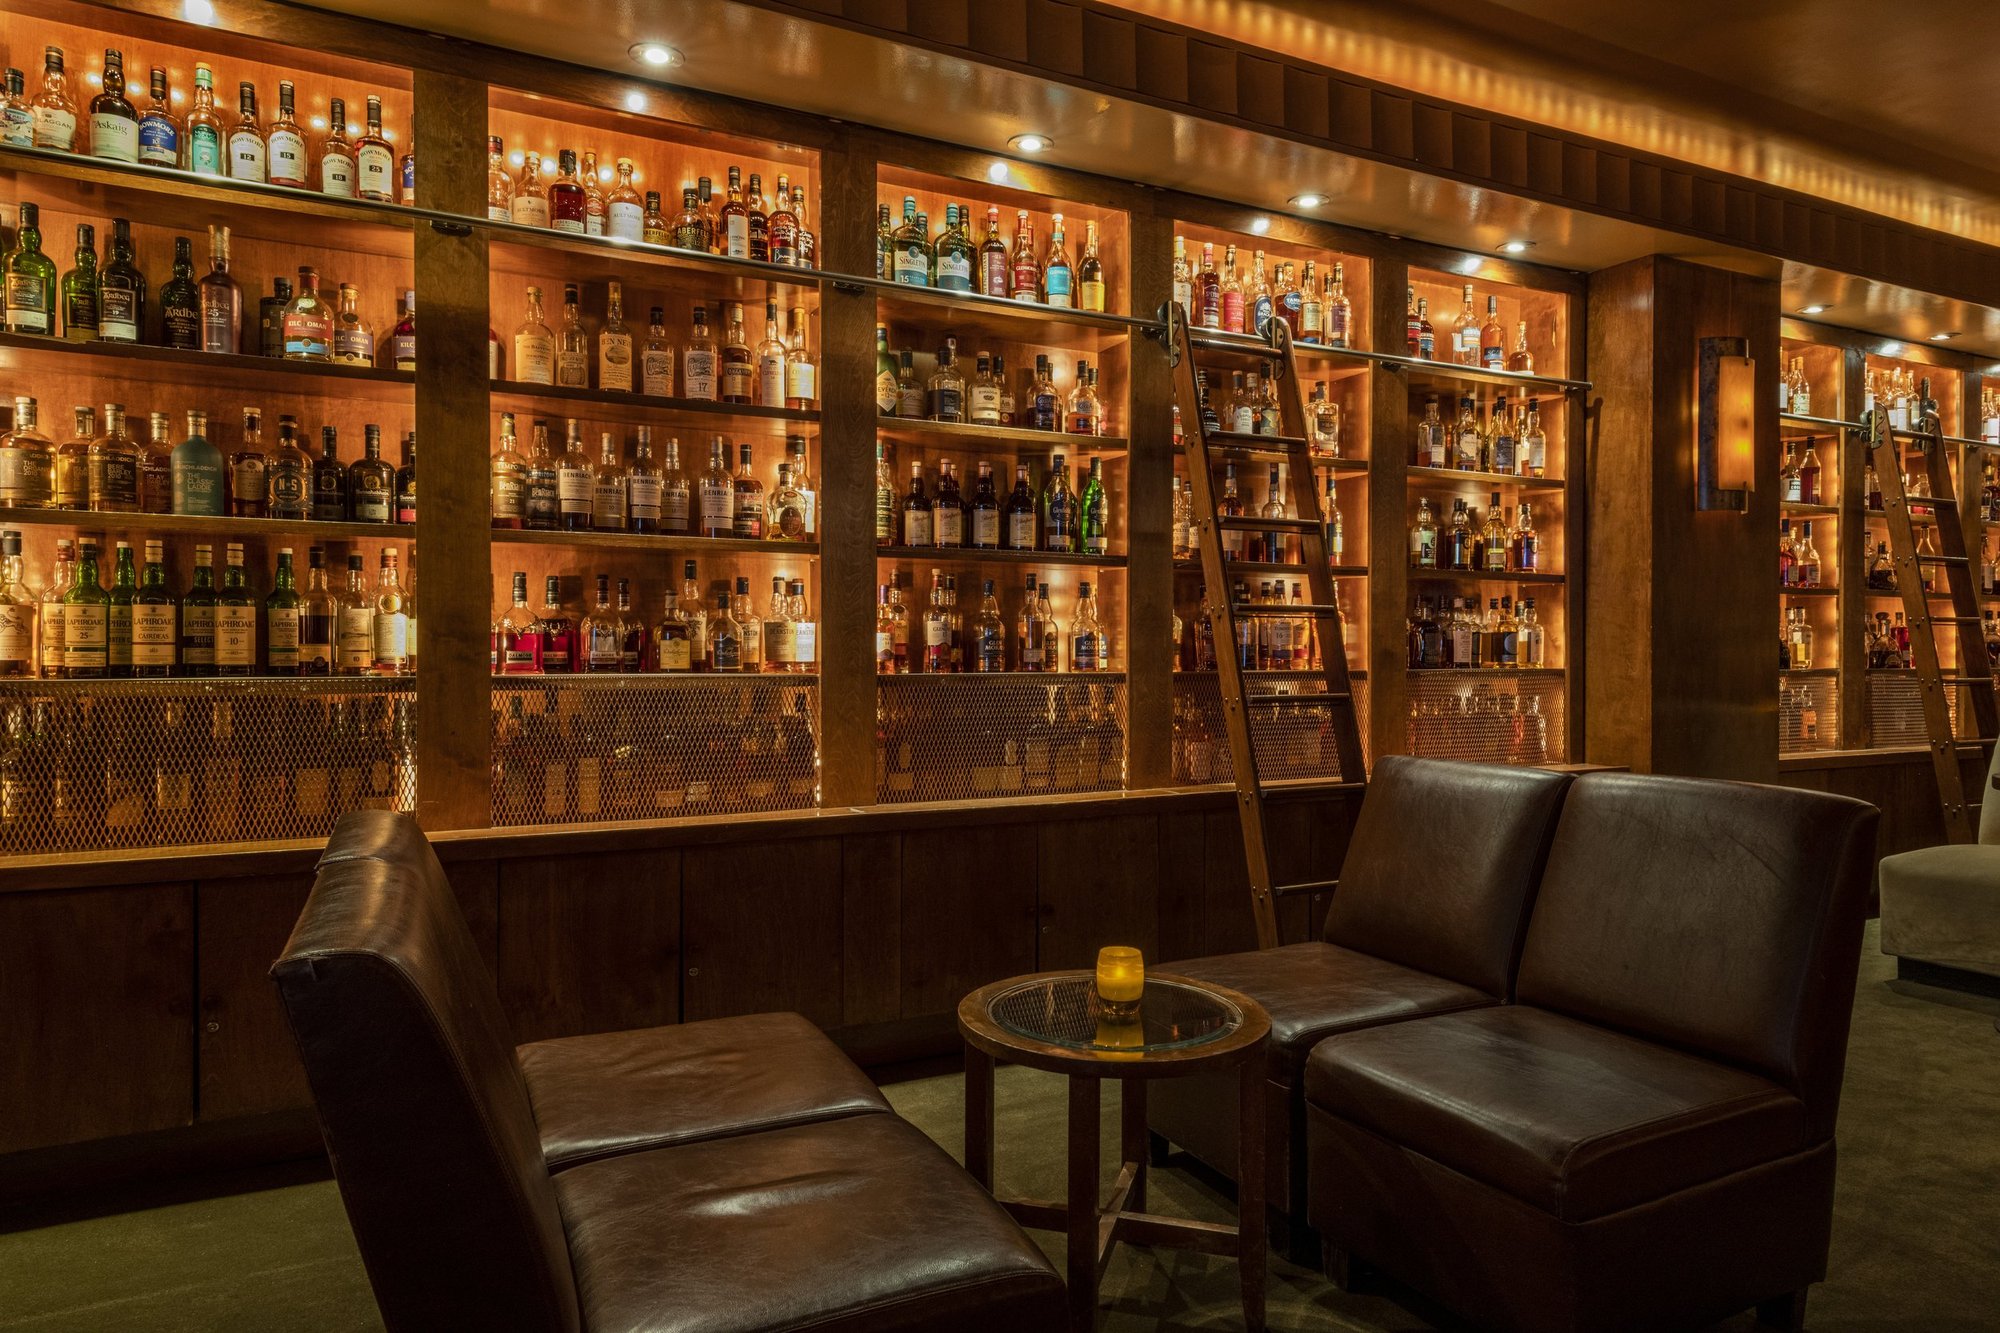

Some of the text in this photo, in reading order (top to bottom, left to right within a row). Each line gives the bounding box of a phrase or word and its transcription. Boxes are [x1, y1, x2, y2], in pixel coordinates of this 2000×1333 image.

[96, 120, 128, 135] Askaig
[230, 136, 264, 149] BOWMORE
[270, 135, 304, 148] BOWMORE
[360, 150, 391, 162] BOWMORE
[322, 157, 354, 170] BOWMORE
[900, 274, 910, 283] 15
[288, 320, 327, 330] KILCOMAN
[699, 382, 708, 392] 17
[66, 618, 104, 626] LAPHROAIG
[133, 617, 174, 626] LAPHROAIG
[216, 620, 255, 628] LAPHROAIG
[79, 631, 89, 640] 25
[229, 636, 239, 646] 10
